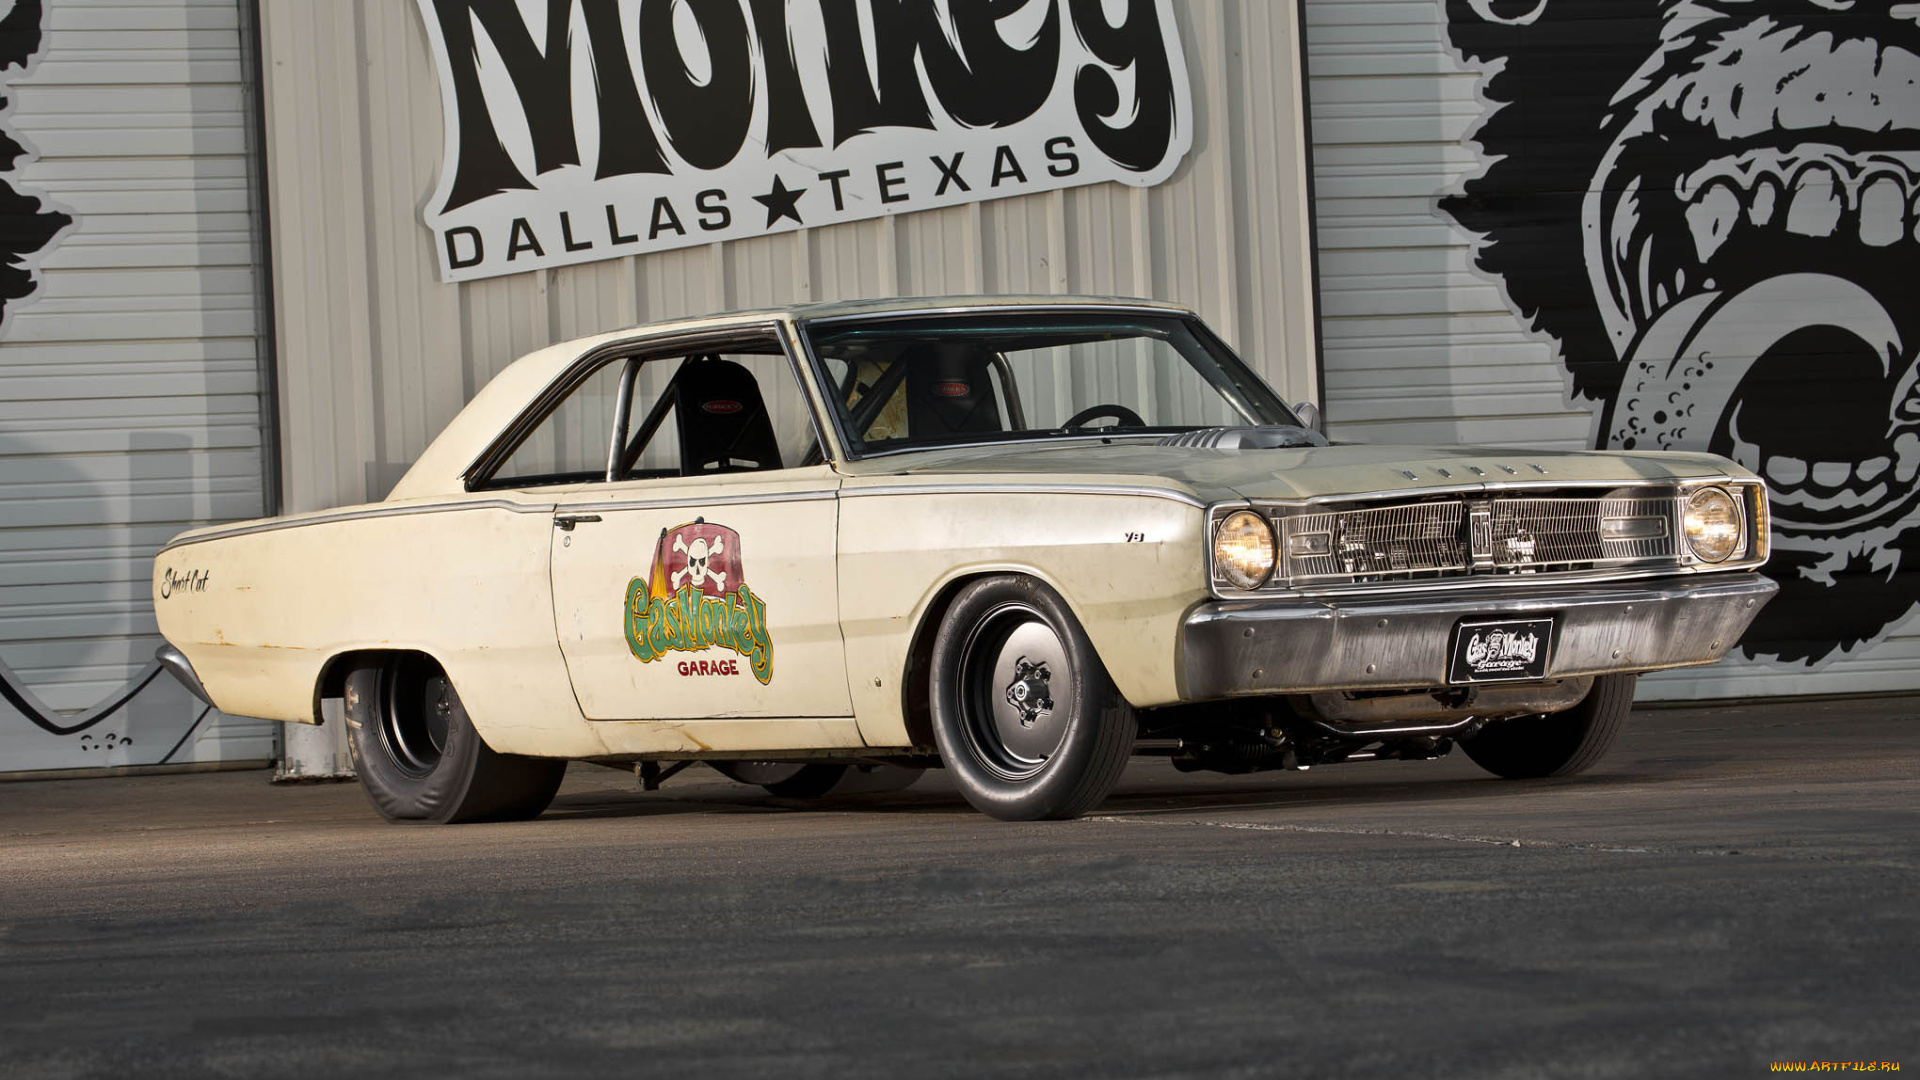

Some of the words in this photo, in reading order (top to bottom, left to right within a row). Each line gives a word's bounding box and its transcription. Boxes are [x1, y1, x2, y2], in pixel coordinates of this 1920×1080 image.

[445, 188, 731, 269] DALLAS
[818, 135, 1080, 211] TEXAS
[1466, 633, 1488, 665] Gas
[1499, 630, 1539, 663] Monkey
[677, 659, 739, 676] GARAGE
[1477, 659, 1522, 670] Garage
